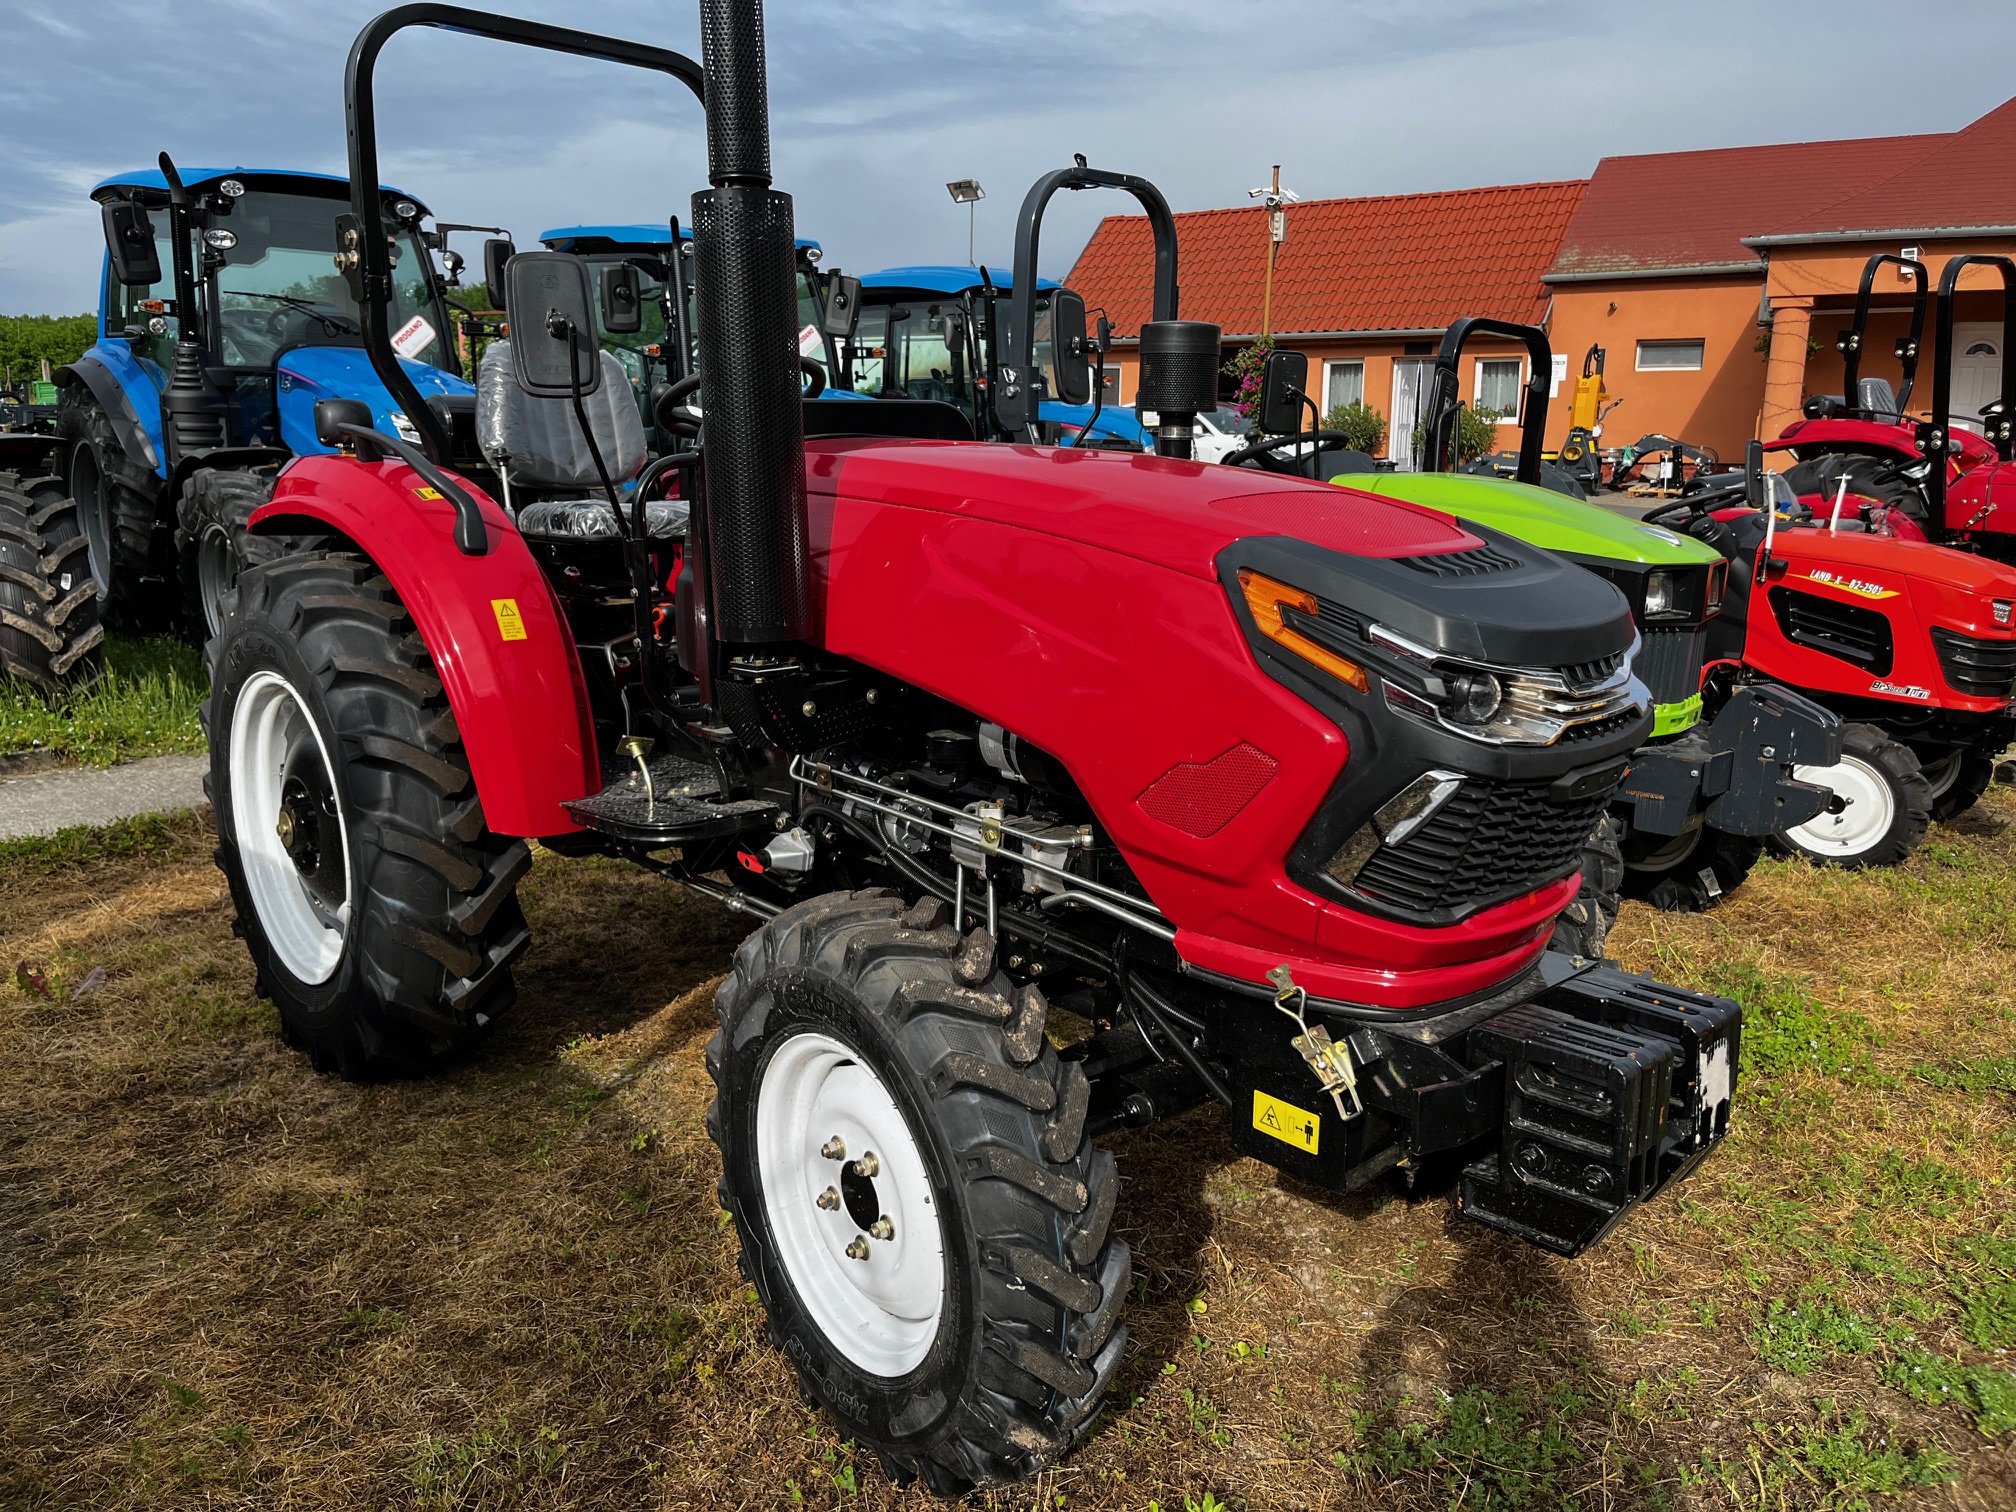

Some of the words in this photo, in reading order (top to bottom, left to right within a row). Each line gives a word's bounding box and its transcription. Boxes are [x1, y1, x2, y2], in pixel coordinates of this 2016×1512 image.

[394, 320, 423, 347] PRODANO
[1809, 569, 1831, 582] LAND
[1833, 575, 1843, 585] X
[1848, 579, 1884, 596] B2-2501
